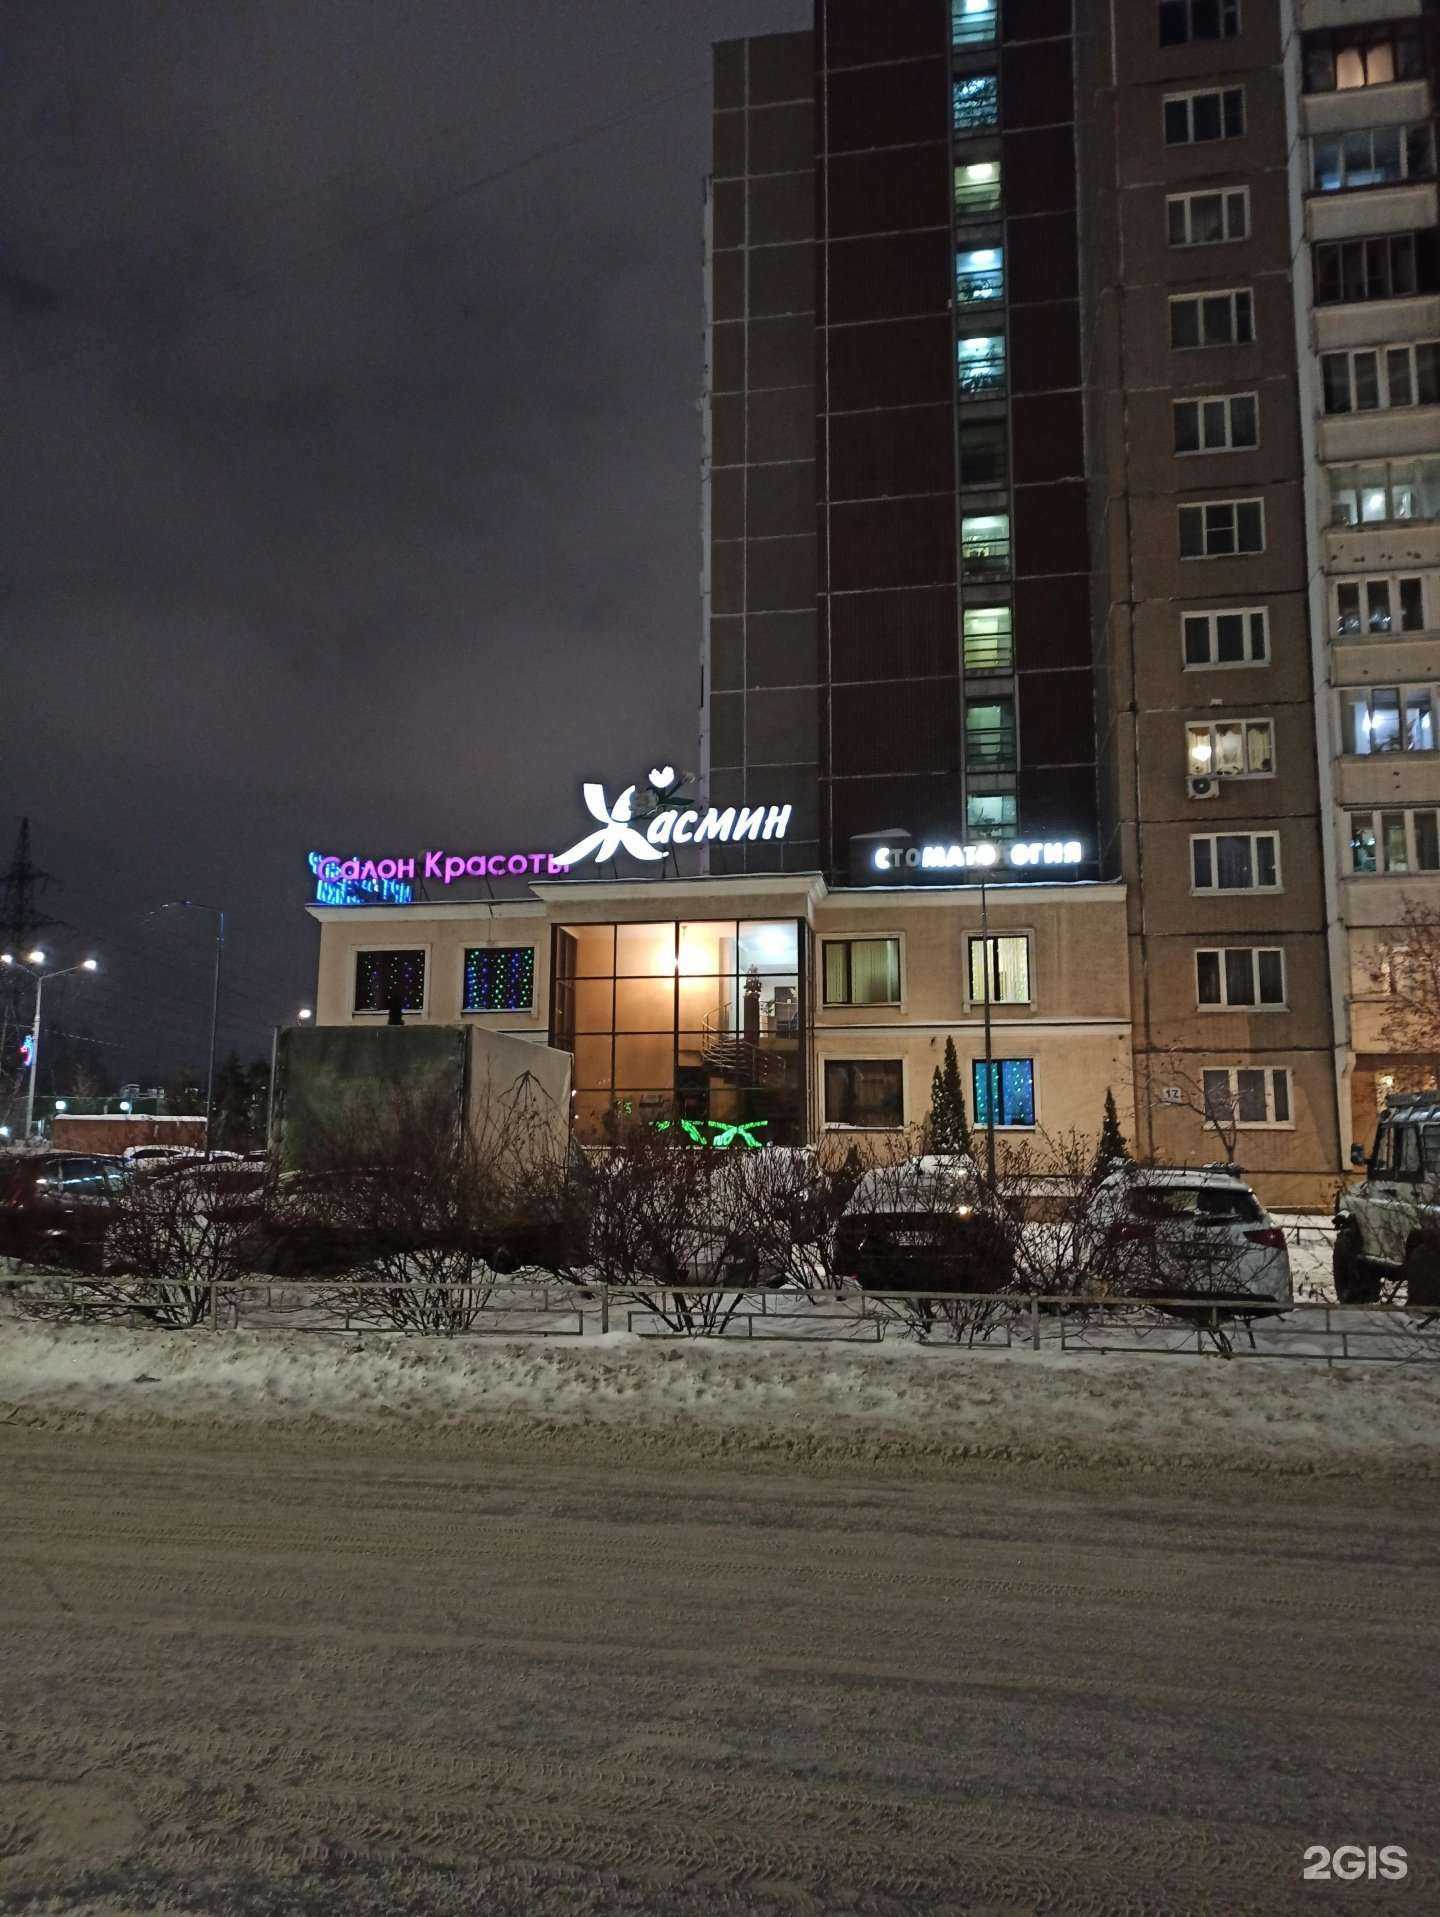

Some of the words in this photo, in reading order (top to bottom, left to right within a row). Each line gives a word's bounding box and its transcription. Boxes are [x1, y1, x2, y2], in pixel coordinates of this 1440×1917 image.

[552, 783, 793, 863] Жасмин
[317, 855, 415, 882] Салон
[425, 850, 570, 884] Красоты
[874, 841, 1082, 869] СТОМАТООГИЯ
